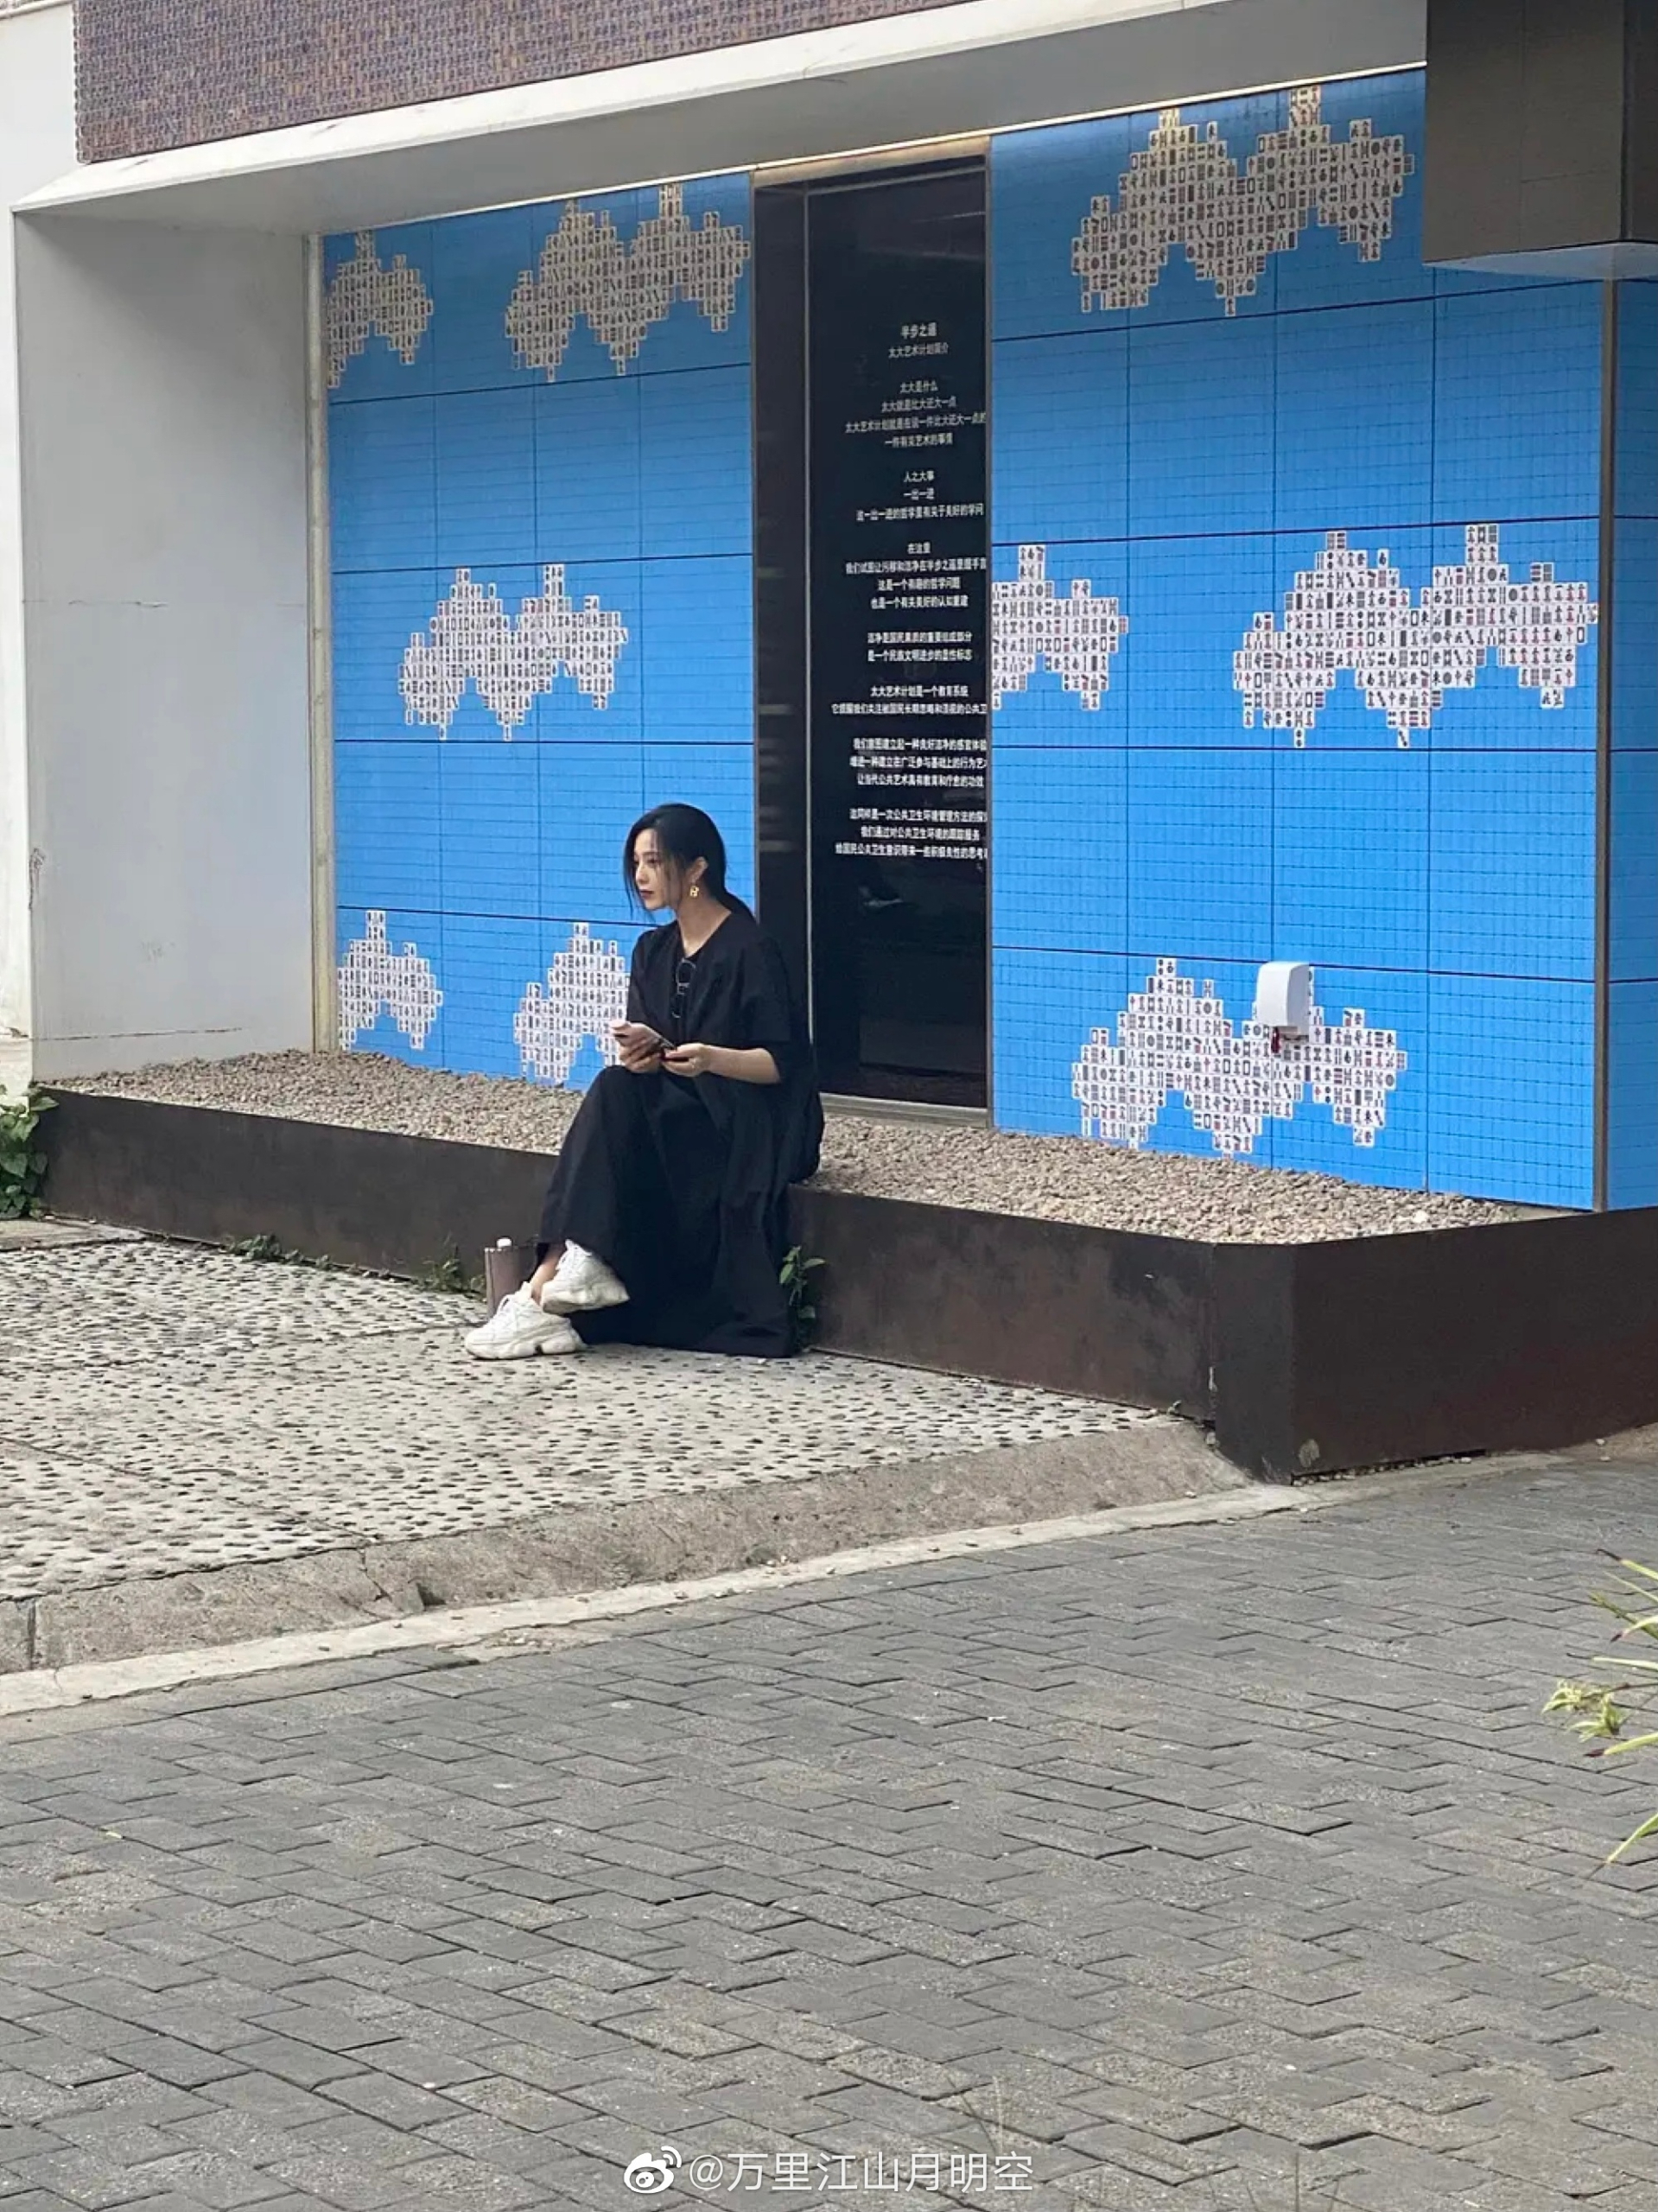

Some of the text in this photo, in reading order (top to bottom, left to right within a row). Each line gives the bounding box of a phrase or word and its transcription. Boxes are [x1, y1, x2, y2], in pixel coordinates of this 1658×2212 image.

[906, 541, 932, 555] 在这里
[869, 683, 969, 698] 太大艺术计划是一个教育系统
